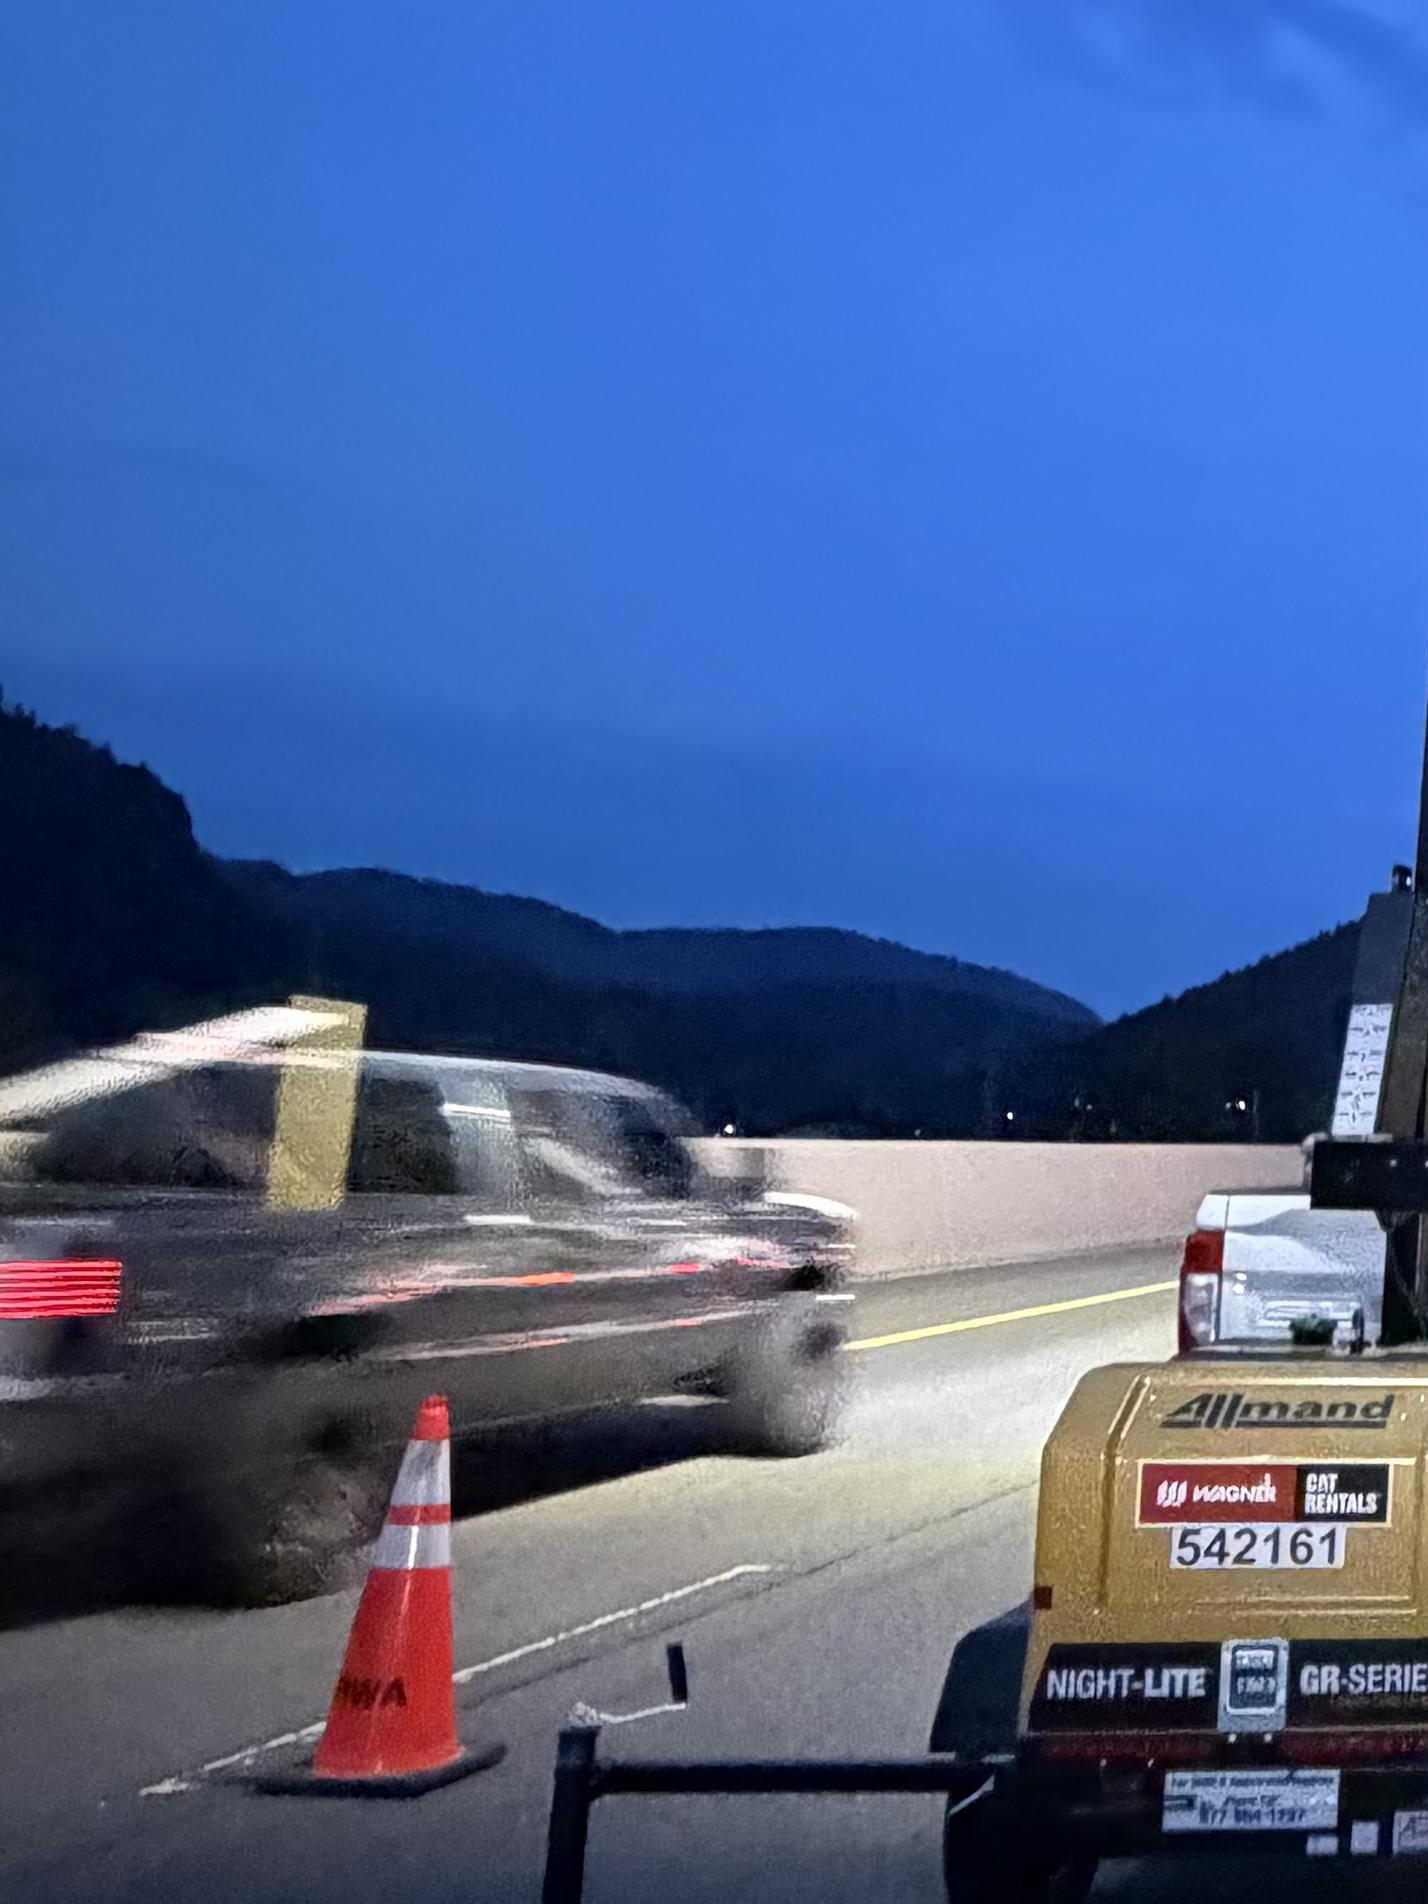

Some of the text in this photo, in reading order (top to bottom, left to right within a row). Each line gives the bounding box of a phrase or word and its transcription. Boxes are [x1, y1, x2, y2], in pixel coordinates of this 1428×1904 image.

[1160, 1392, 1395, 1428] Allmand
[1305, 1473, 1338, 1494] CAT
[1304, 1492, 1378, 1515] RENTALS
[1176, 1527, 1337, 1566] 542161
[1046, 1666, 1208, 1700] NIGHT-LITE
